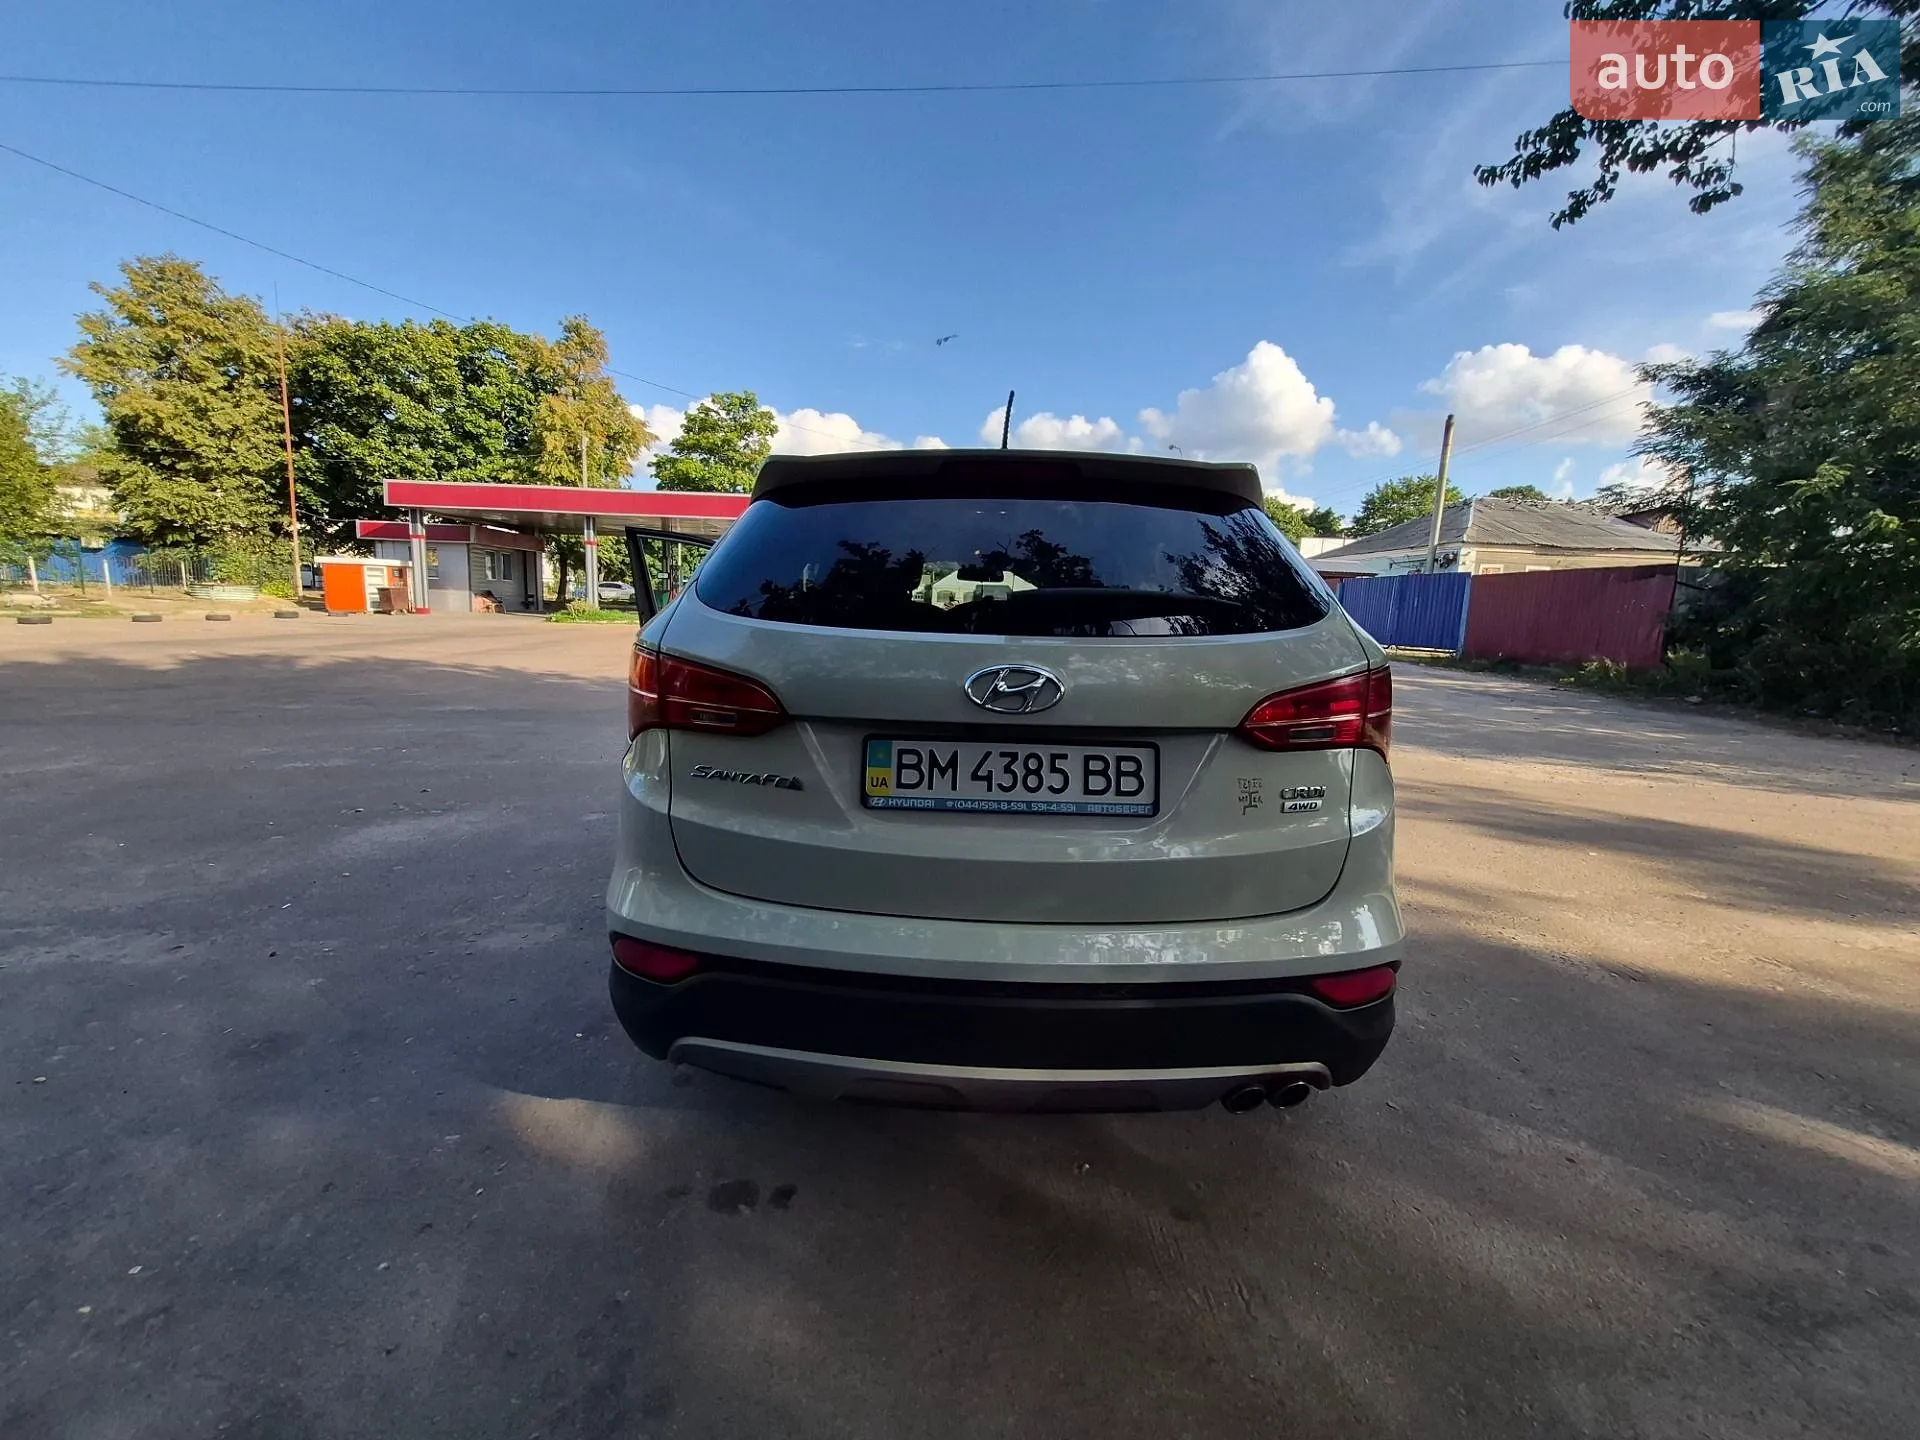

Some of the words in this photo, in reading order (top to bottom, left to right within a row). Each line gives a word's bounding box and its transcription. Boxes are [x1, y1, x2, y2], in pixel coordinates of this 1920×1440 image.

[896, 748, 959, 791] BM
[970, 750, 1070, 795] 4385
[1083, 754, 1145, 797] BB
[870, 777, 888, 788] UA
[888, 799, 934, 808] HYUNDAI
[1288, 801, 1318, 811] 4WD
